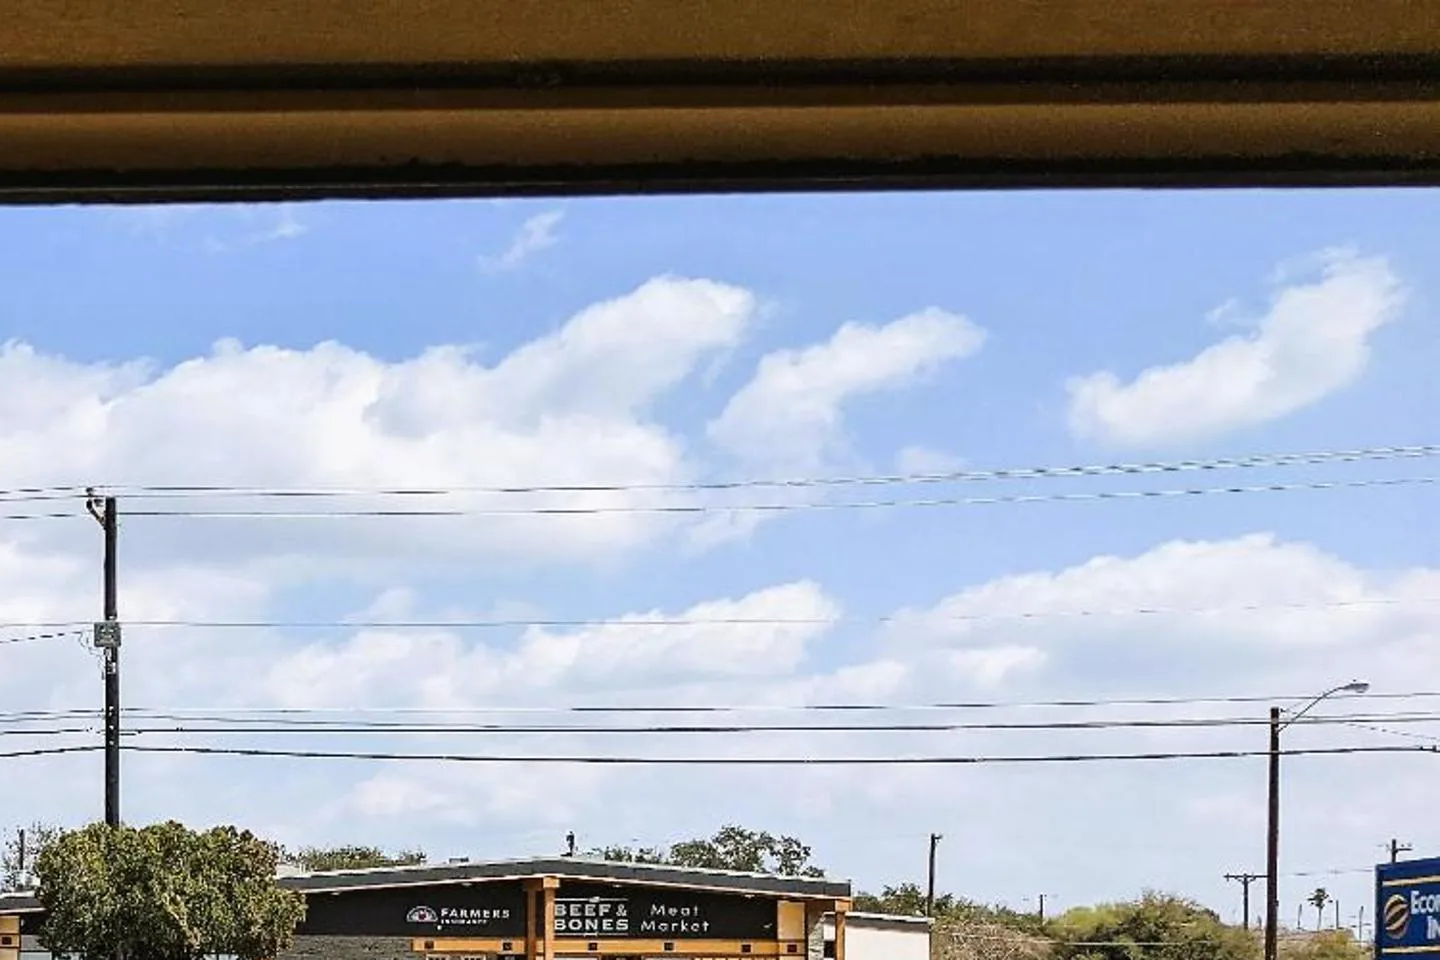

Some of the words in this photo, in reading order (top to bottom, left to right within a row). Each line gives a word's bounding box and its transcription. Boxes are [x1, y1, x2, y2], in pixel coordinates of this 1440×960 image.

[441, 908, 510, 918] FARMERS
[554, 904, 611, 917] BEEF
[616, 904, 627, 917] &
[650, 904, 698, 917] Meat
[554, 919, 629, 931] BONES
[640, 920, 710, 932] Market
